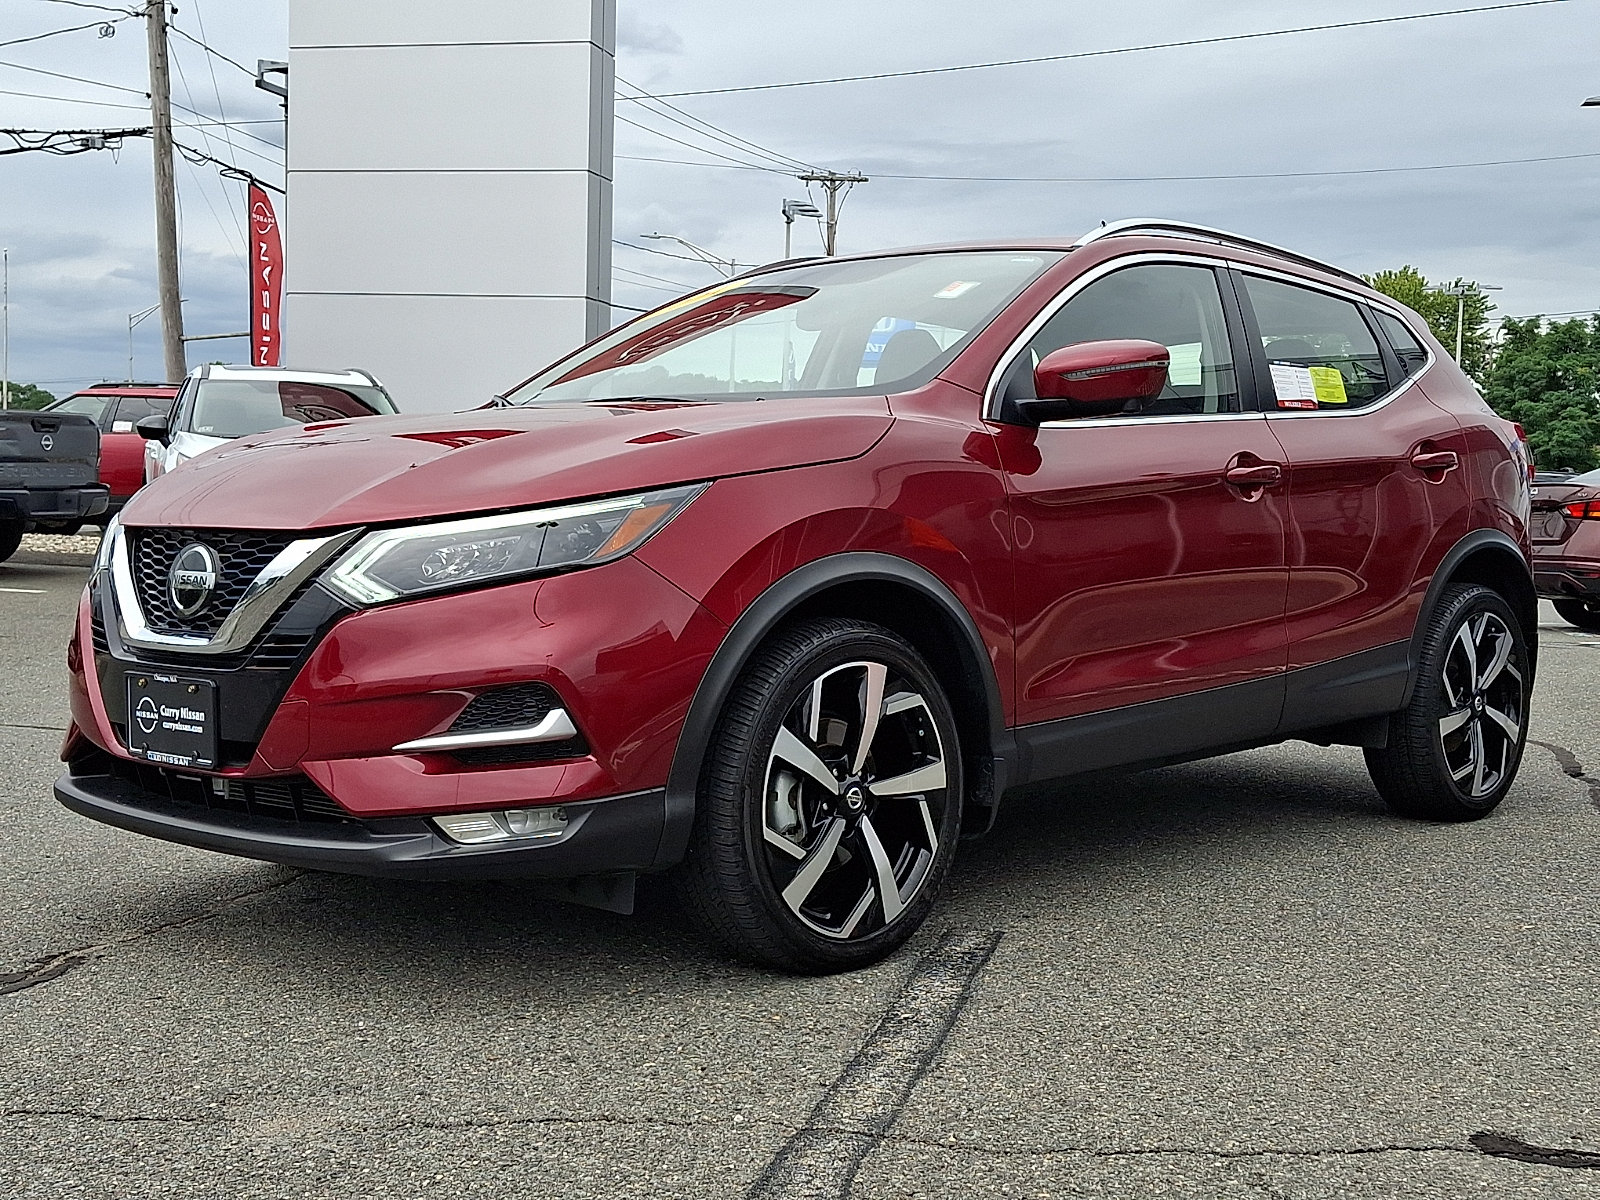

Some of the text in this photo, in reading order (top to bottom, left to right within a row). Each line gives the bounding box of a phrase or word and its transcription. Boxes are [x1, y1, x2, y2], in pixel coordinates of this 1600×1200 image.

[174, 573, 208, 586] NISSAN
[136, 710, 159, 720] NISSAN
[160, 704, 205, 721] Curry Nissan
